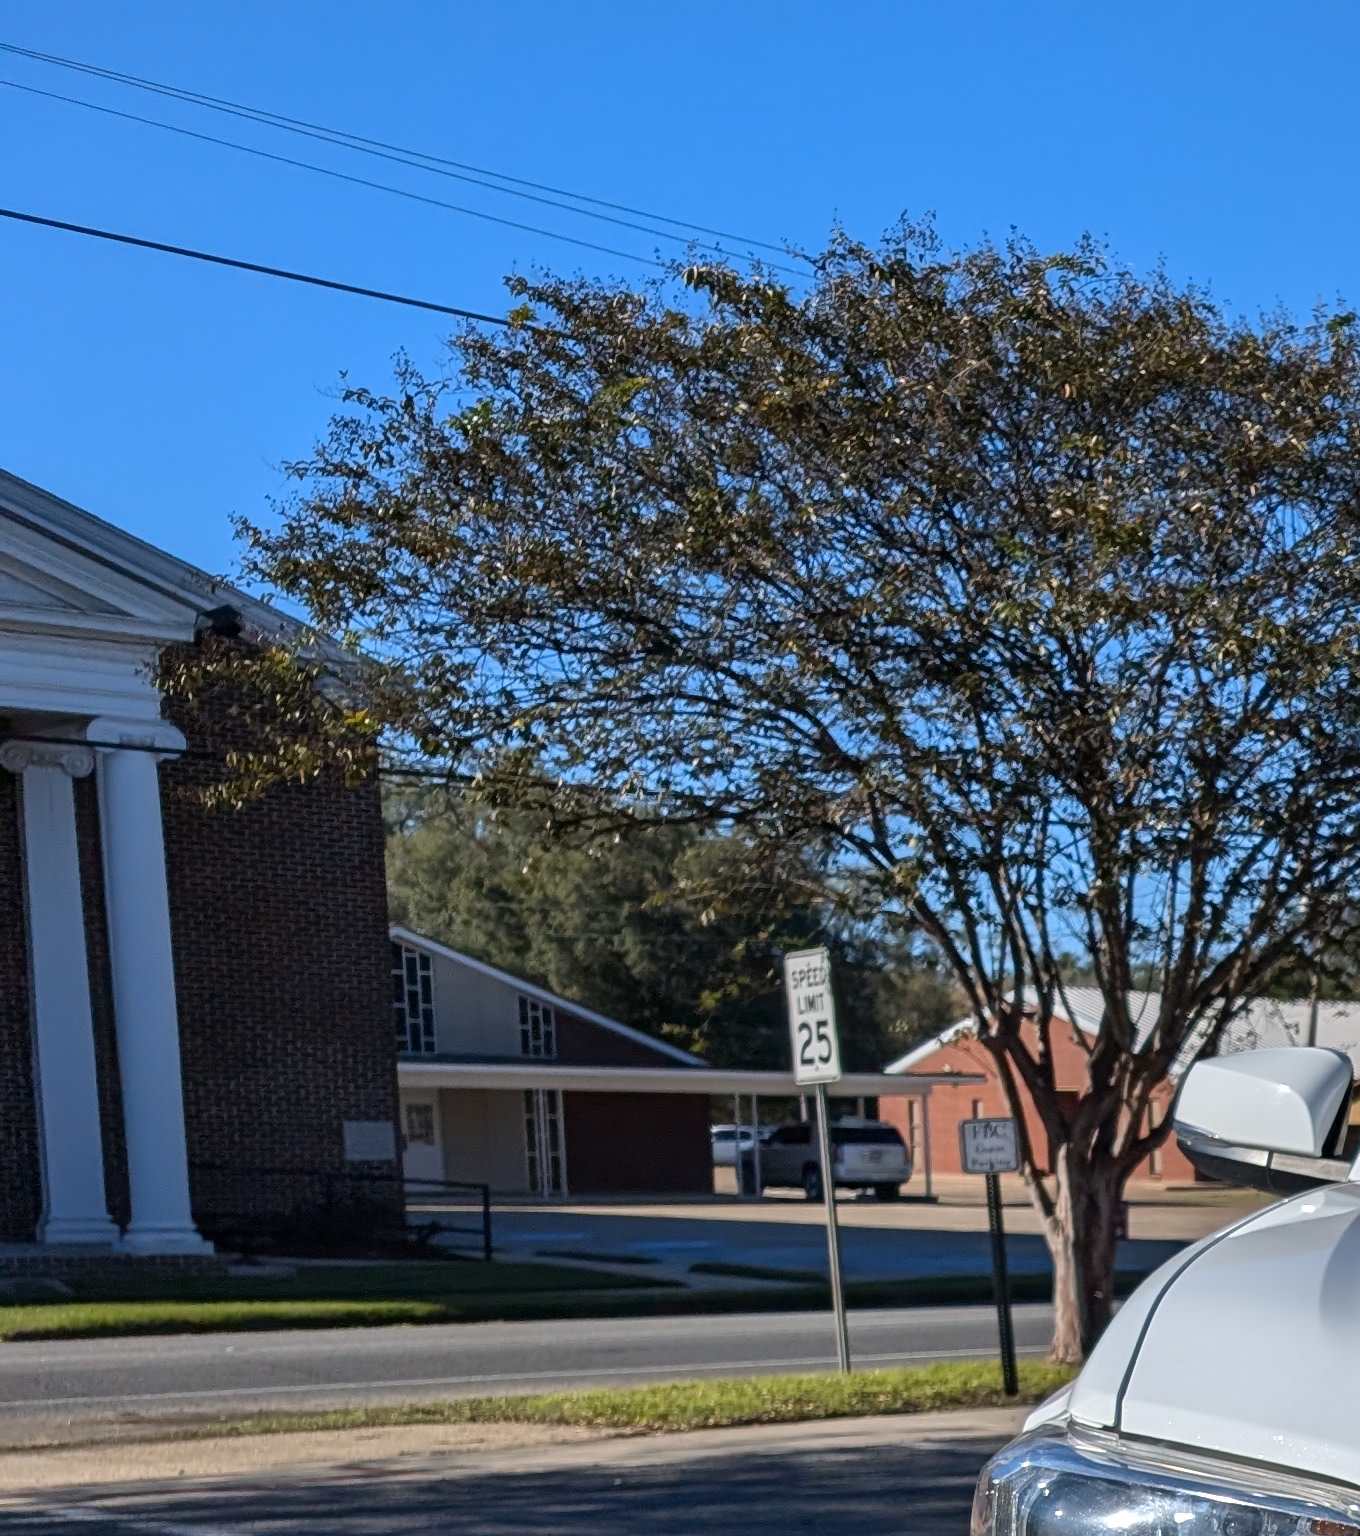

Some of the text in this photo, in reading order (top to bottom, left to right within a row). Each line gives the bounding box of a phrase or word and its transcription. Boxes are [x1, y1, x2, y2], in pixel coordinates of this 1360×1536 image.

[791, 966, 827, 990] SPEED
[797, 992, 825, 1015] LIMIT
[797, 1019, 832, 1065] 25
